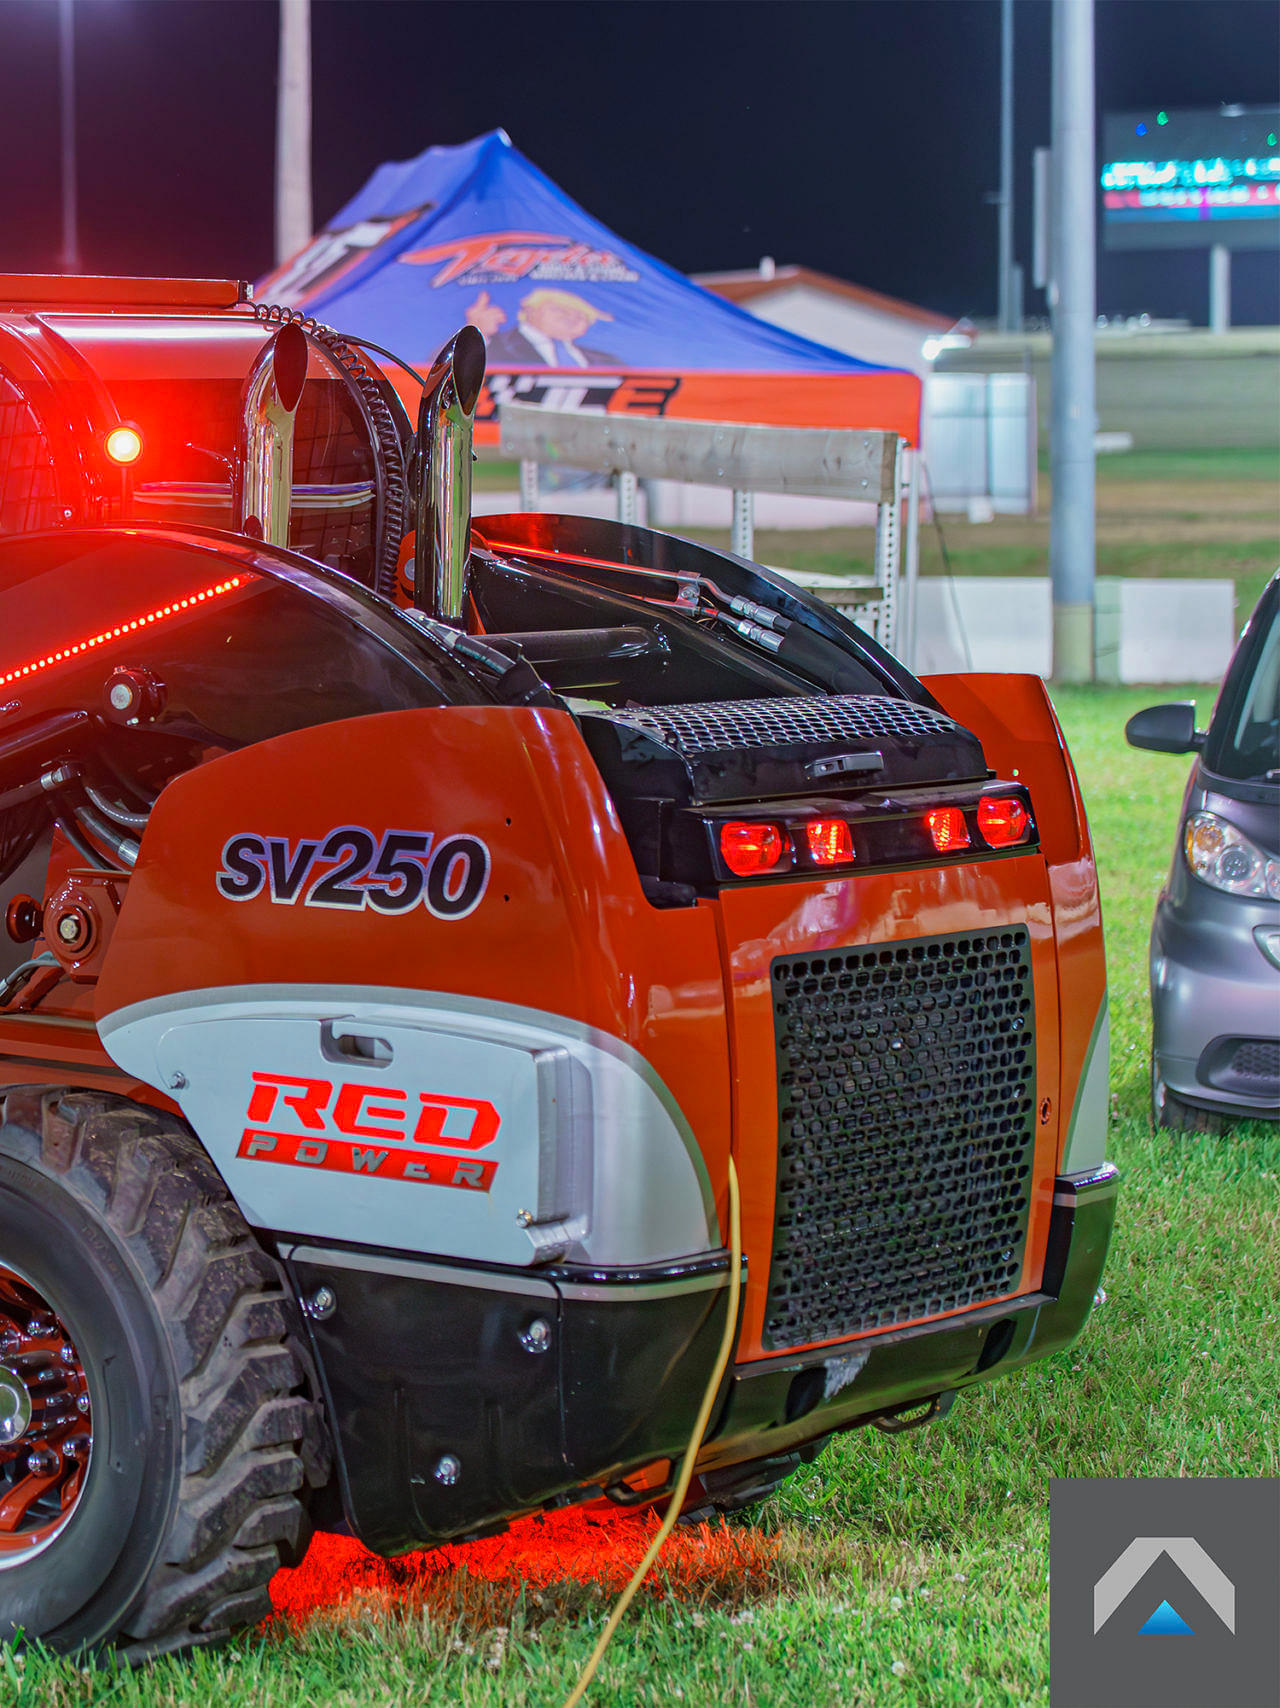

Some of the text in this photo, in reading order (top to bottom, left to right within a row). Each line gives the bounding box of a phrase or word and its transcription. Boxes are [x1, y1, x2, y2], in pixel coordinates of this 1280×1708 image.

[215, 824, 492, 921] SV250
[246, 1071, 502, 1151] RED
[245, 1134, 487, 1188] POWER
